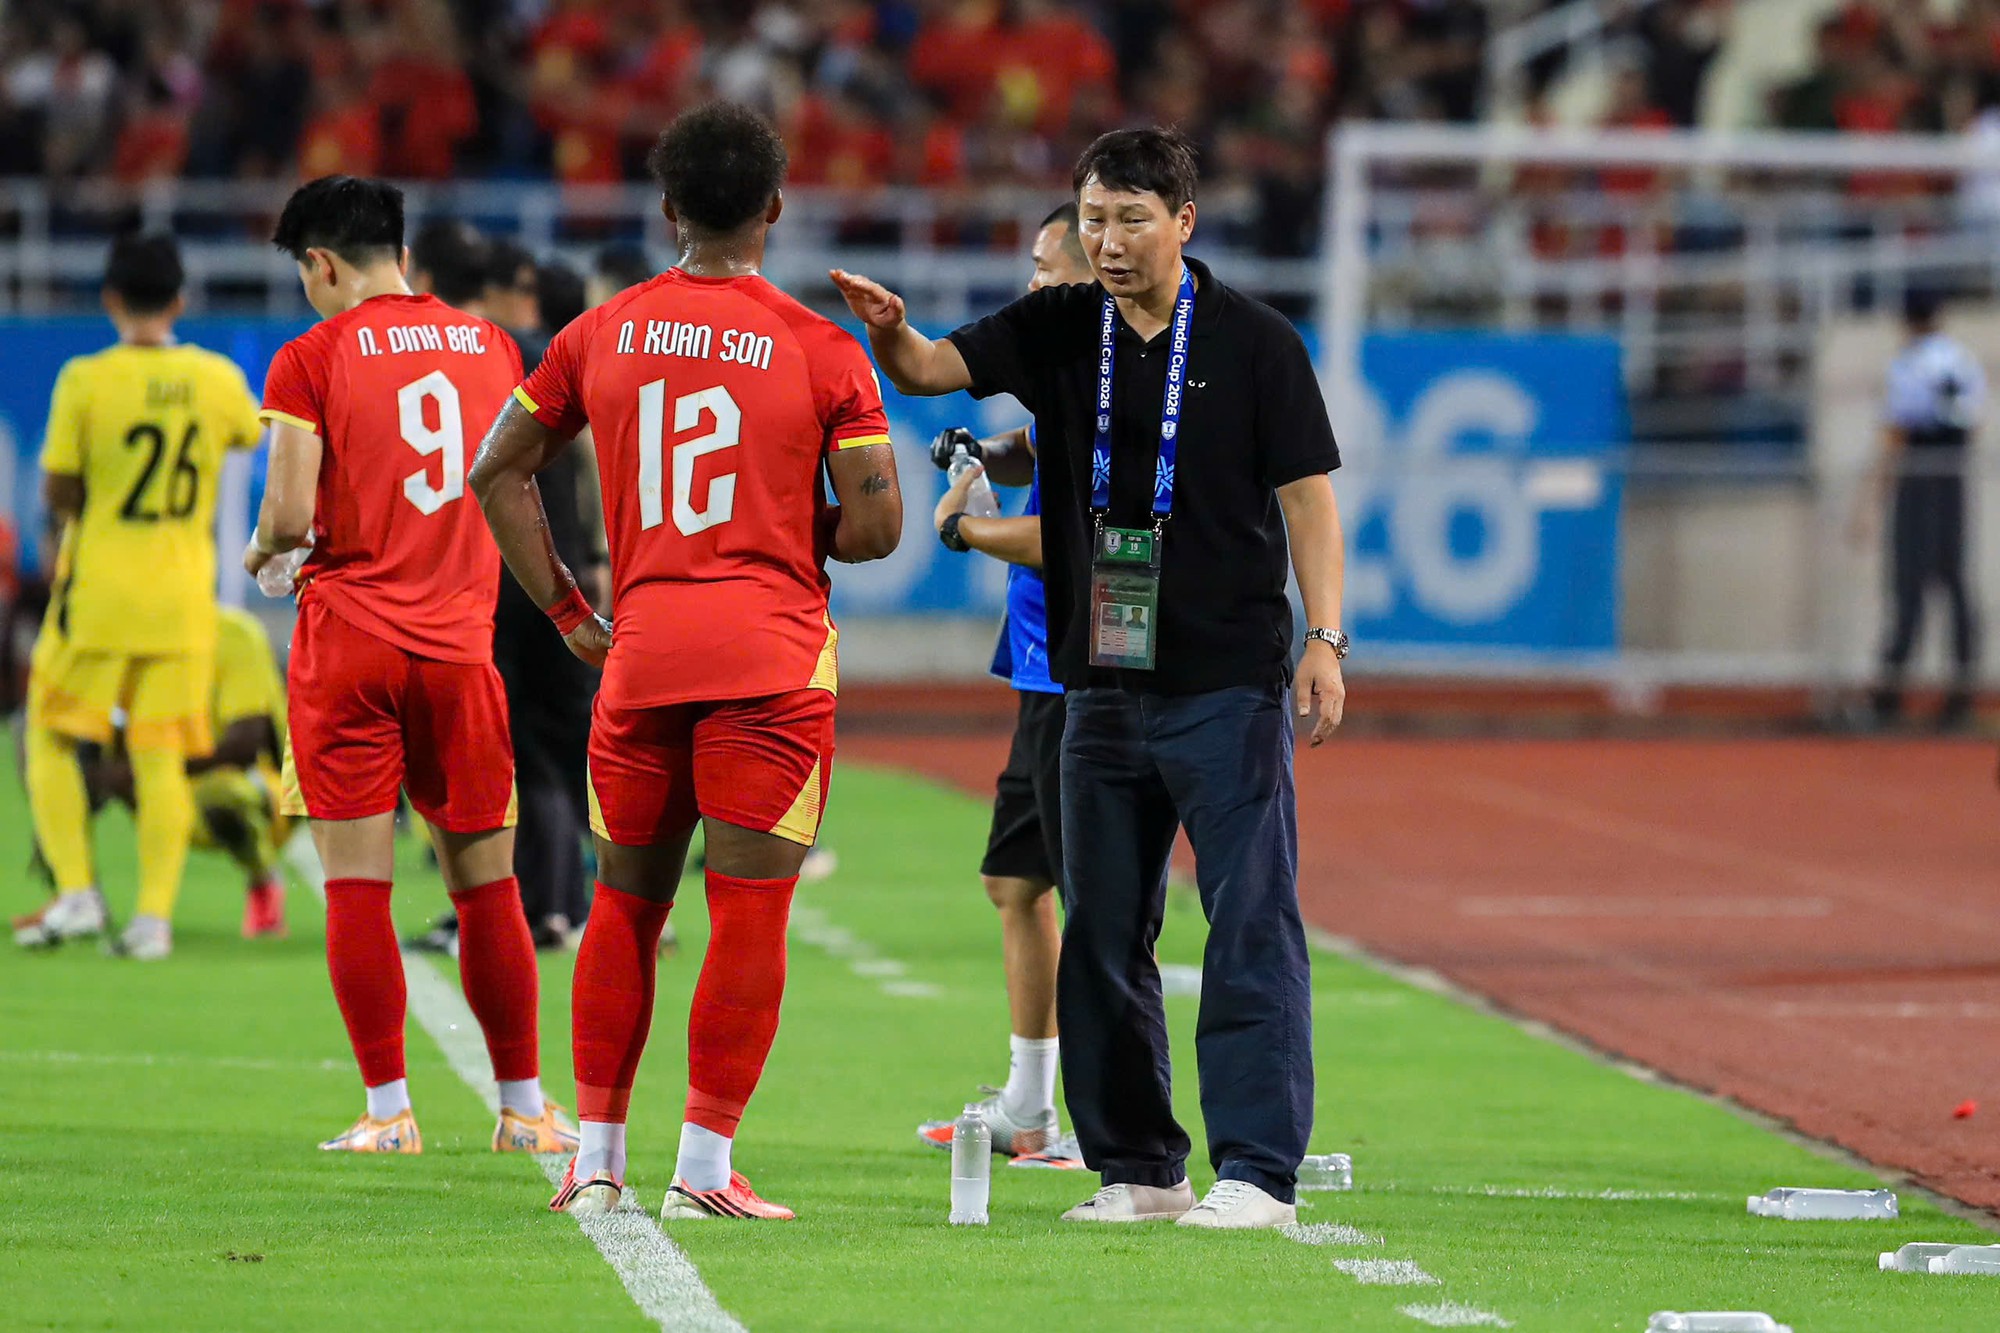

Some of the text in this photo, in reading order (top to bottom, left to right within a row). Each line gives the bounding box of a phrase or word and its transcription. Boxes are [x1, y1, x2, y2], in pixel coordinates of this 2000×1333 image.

[386, 324, 443, 354] DINH
[444, 325, 486, 355] BAC
[643, 319, 713, 359] XUAN
[719, 328, 774, 370] SON
[1100, 347, 1112, 375] Cup
[1166, 299, 1191, 416] Hyundai Cup 2026
[1100, 377, 1111, 409] 2026
[119, 418, 199, 522] 26
[397, 370, 464, 516] 9
[638, 378, 742, 537] 12
